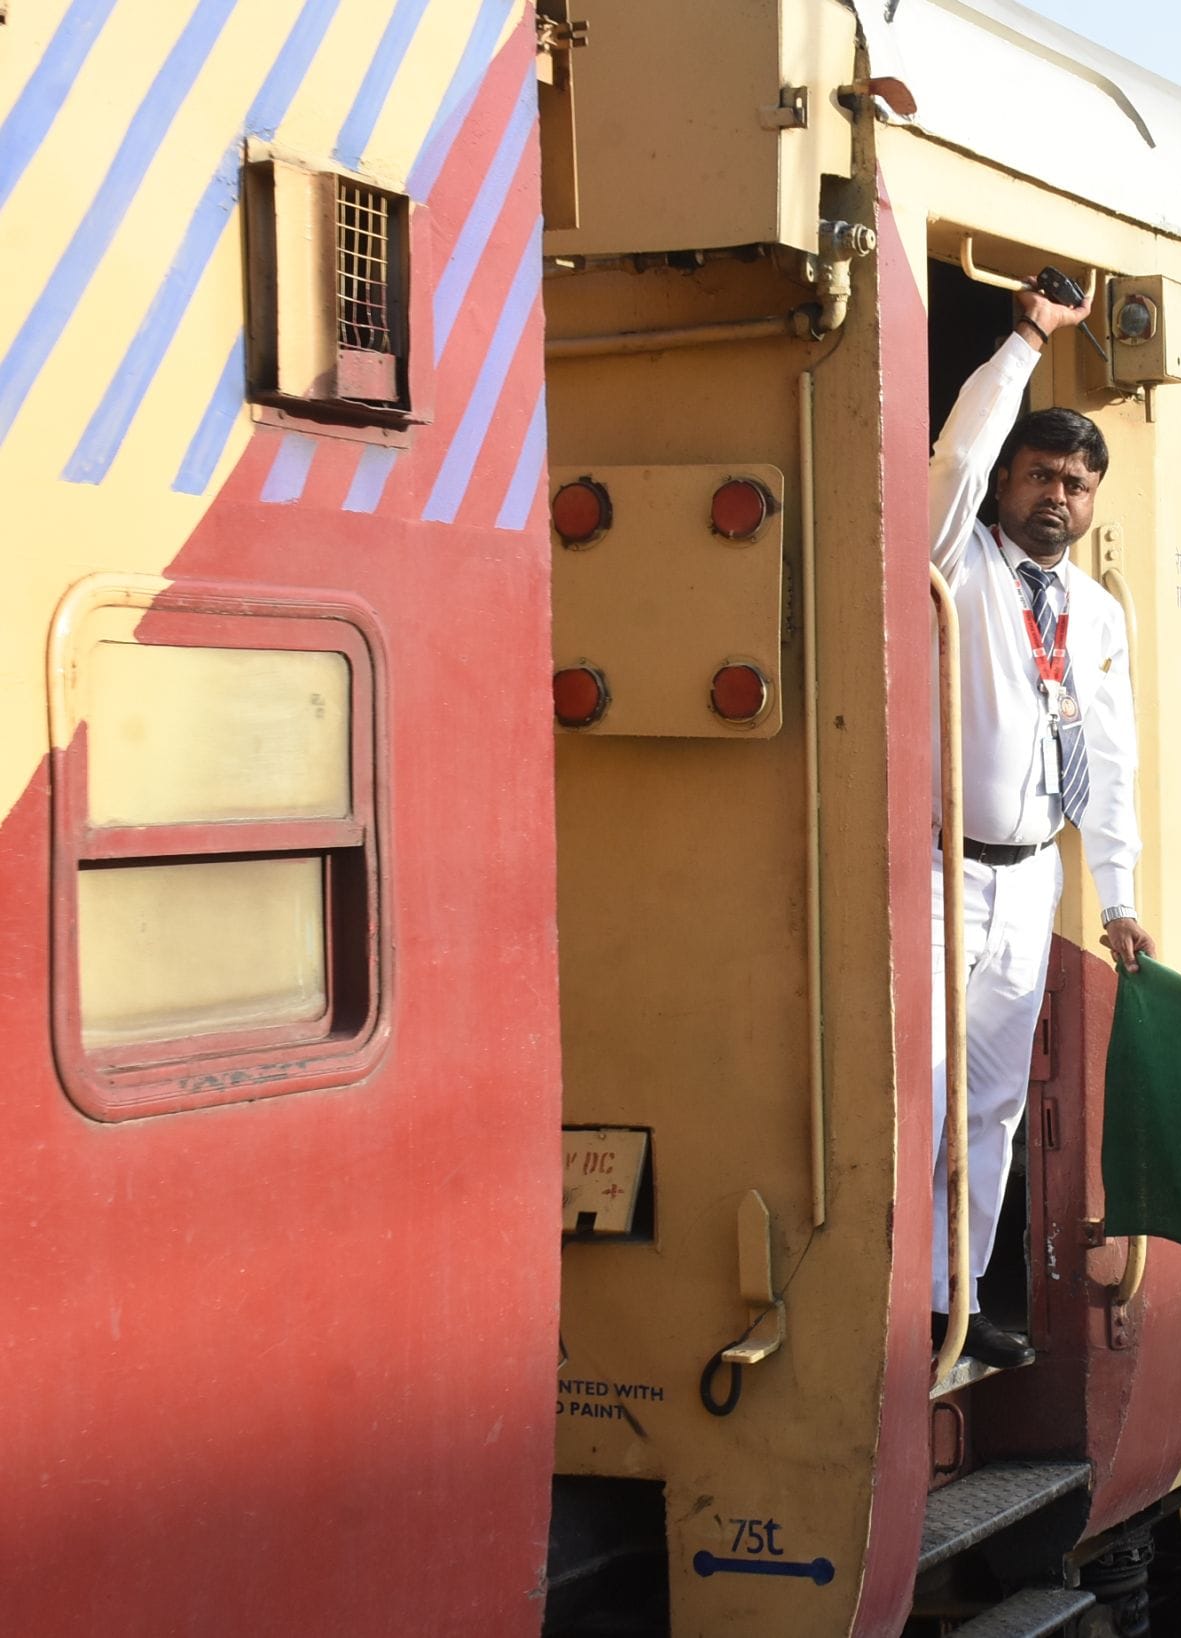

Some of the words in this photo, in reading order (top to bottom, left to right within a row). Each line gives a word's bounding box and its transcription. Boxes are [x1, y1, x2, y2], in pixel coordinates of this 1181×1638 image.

[583, 1152, 615, 1175] DC
[613, 1383, 664, 1401] WITH
[570, 1402, 624, 1420] PAINT
